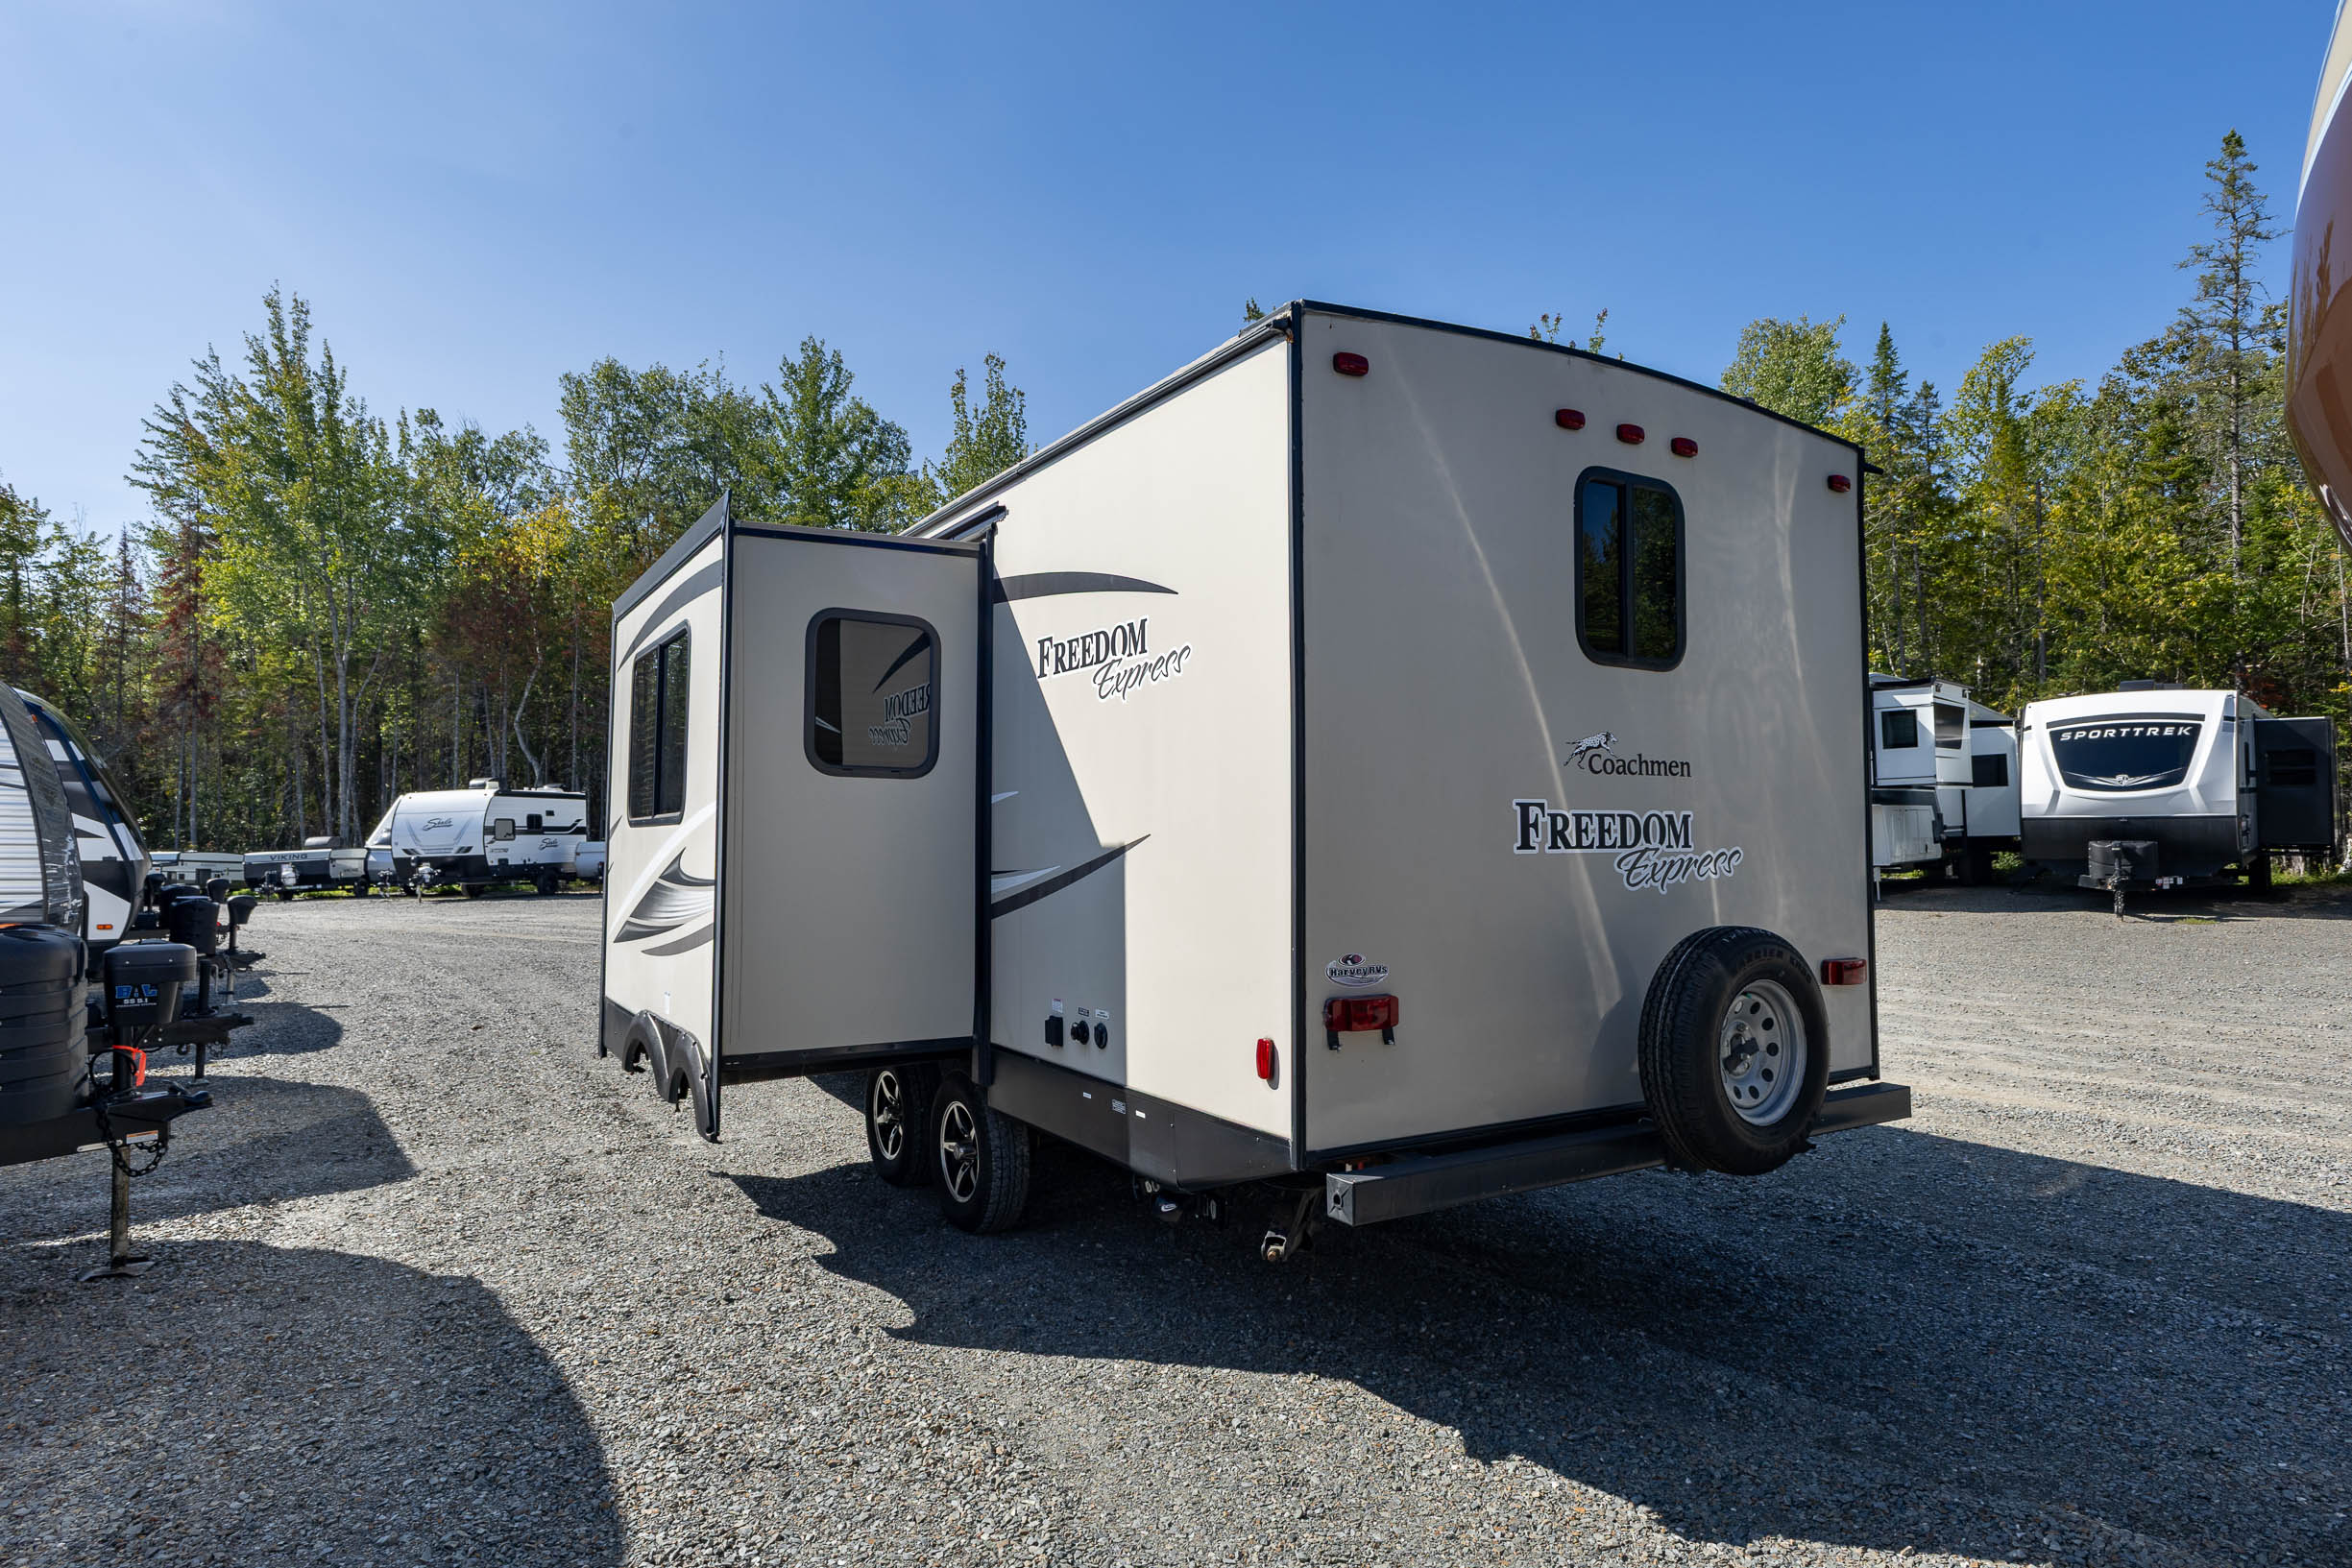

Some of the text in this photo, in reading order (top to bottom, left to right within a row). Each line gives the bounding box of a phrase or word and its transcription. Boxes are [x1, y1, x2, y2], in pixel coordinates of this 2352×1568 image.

[1037, 617, 1148, 679] FREEDOM
[1092, 644, 1192, 700] Express
[2059, 726, 2194, 741] SPORTTREK
[1588, 753, 1692, 778] Coachmen
[1515, 802, 1692, 851] FREEDOM
[269, 853, 307, 861] VIKING
[1615, 846, 1742, 892] Express
